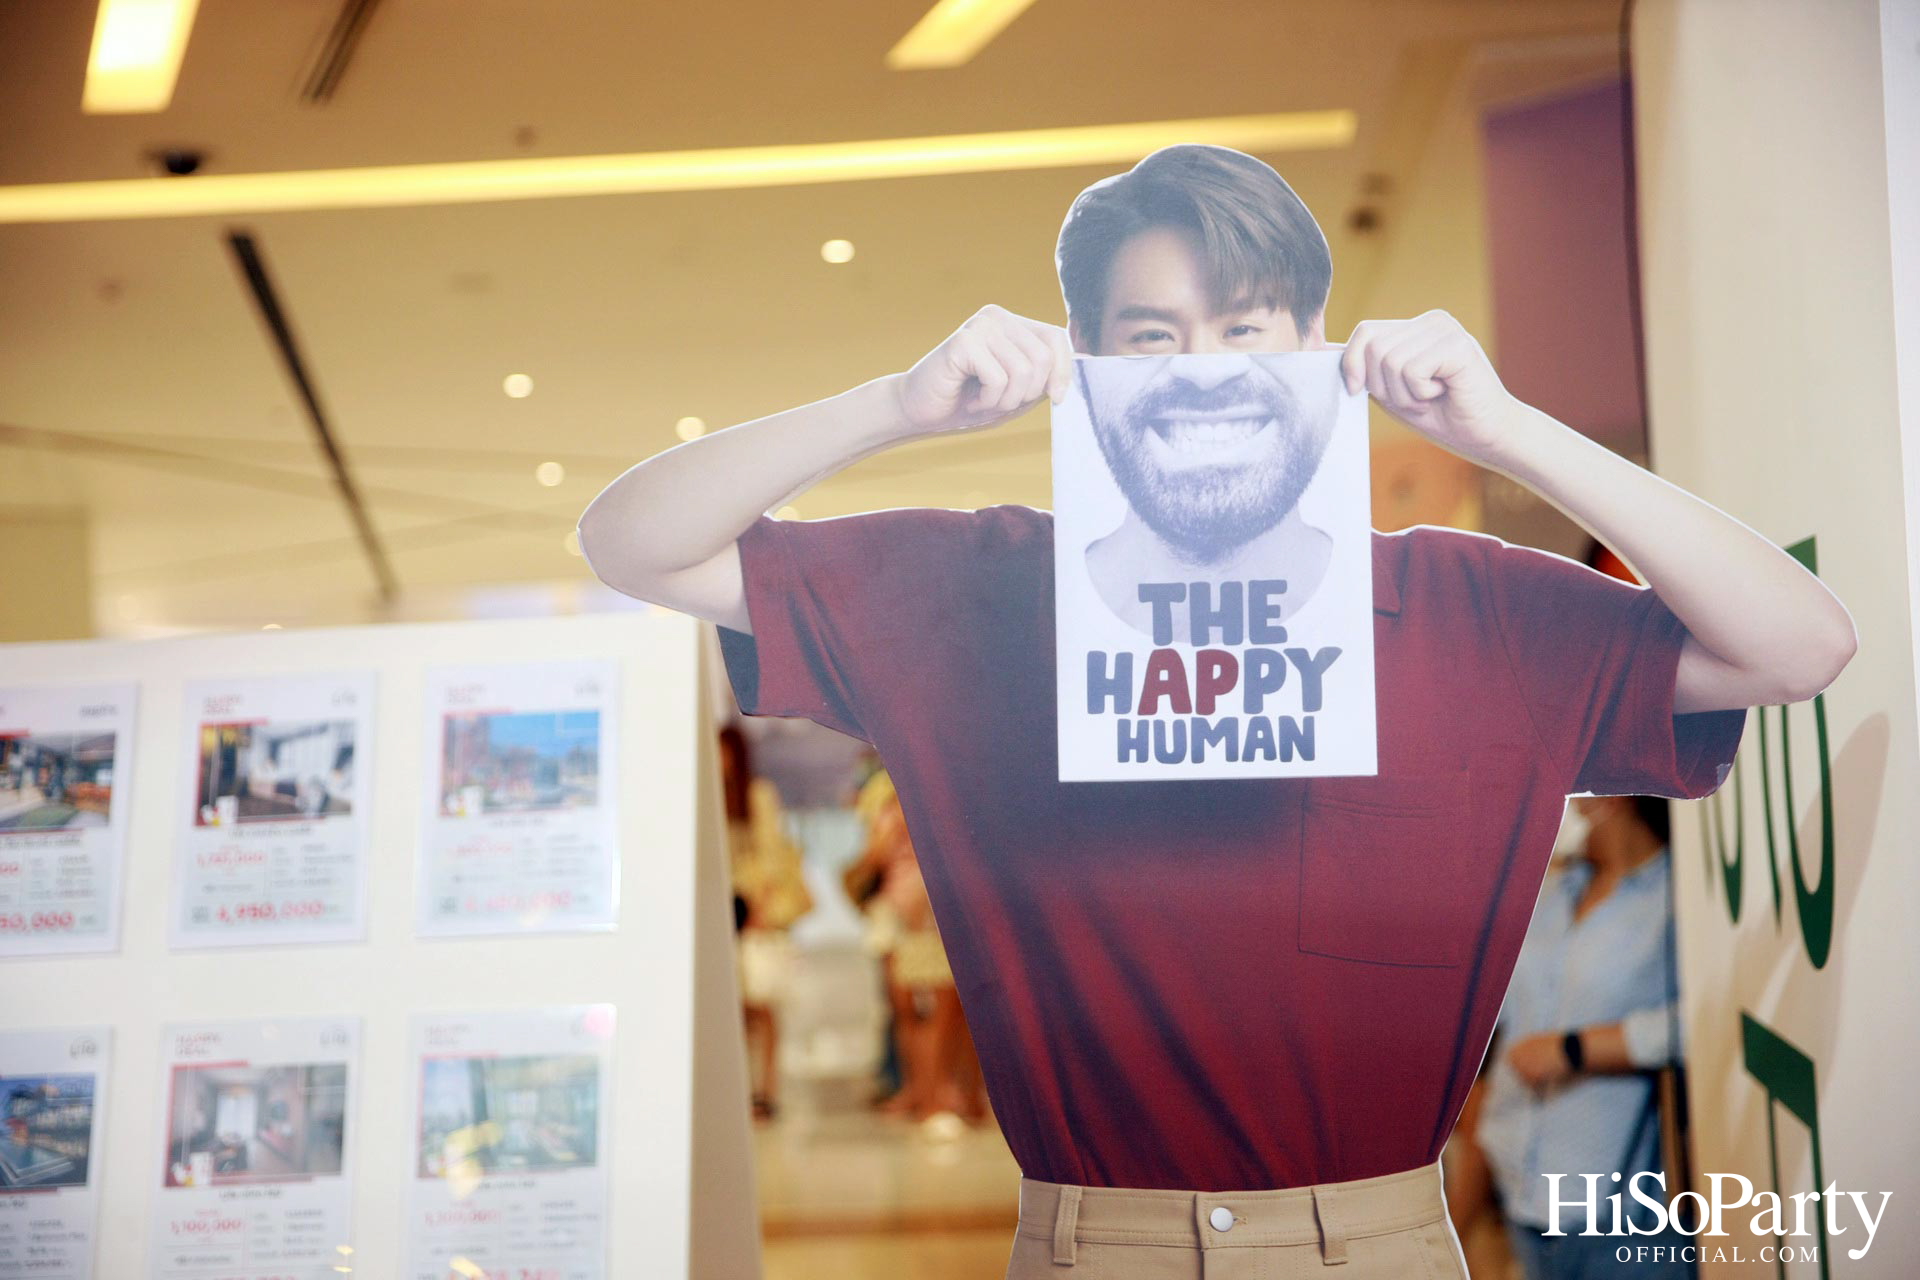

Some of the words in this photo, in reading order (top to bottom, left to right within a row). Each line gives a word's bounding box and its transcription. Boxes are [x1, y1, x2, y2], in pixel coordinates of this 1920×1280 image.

[1138, 579, 1288, 647] THE
[1086, 646, 1343, 716] HAPPY
[1117, 715, 1315, 764] HUMAN
